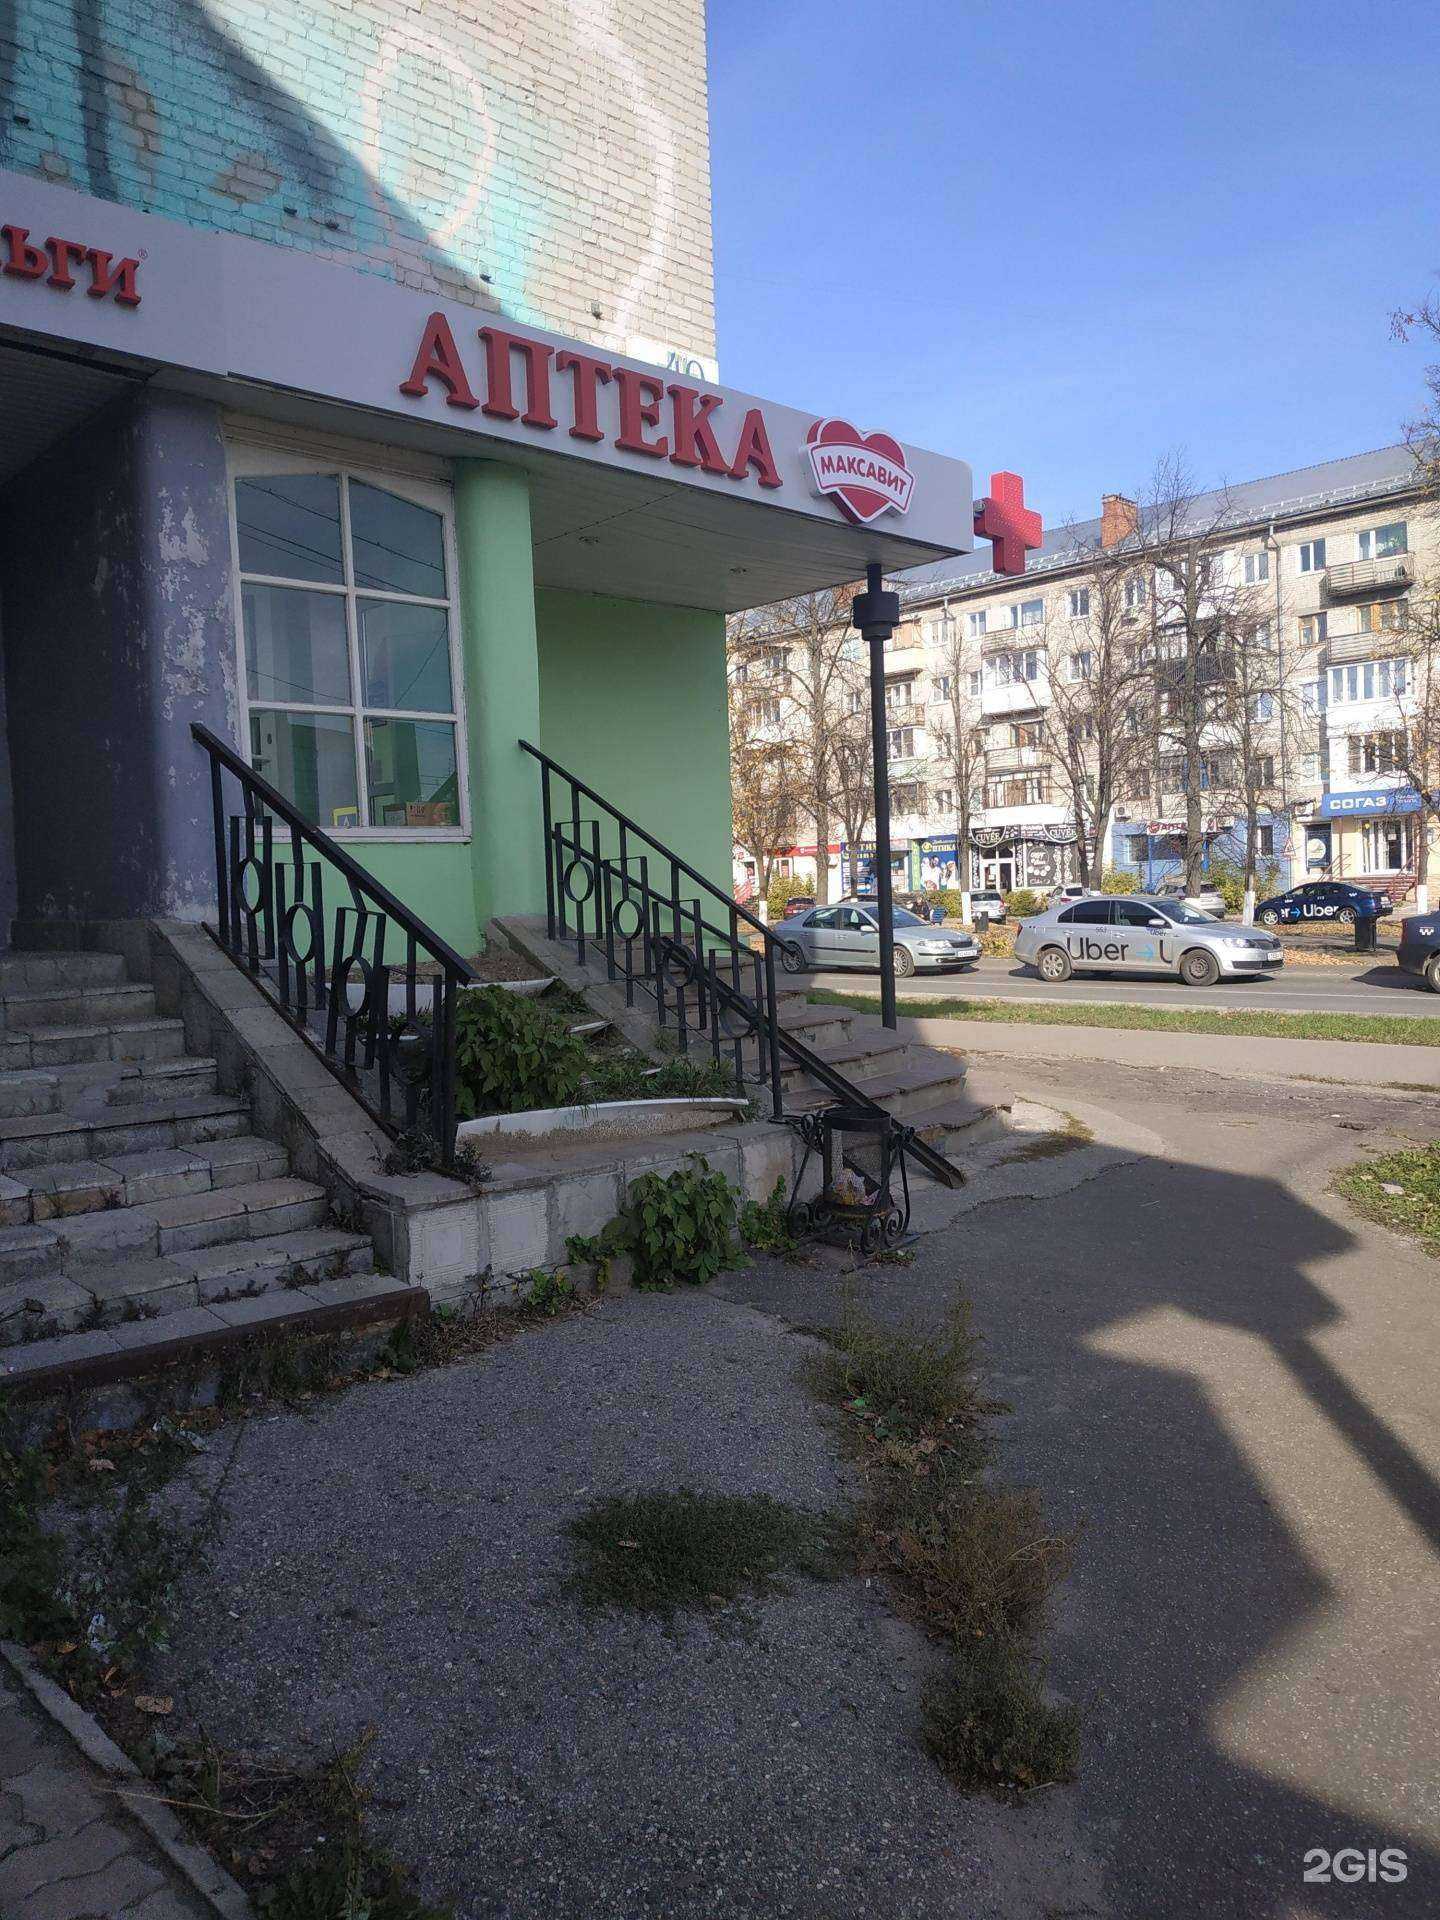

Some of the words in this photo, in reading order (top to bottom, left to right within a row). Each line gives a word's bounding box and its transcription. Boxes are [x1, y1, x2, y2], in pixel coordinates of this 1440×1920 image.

[0, 224, 142, 306] ЬГИ
[399, 311, 783, 489] АПТЕКА
[820, 455, 907, 495] МАКСАВИТ
[1329, 796, 1387, 810] СОГАЗ
[1303, 904, 1340, 917] Uber
[1066, 937, 1130, 961] Uber
